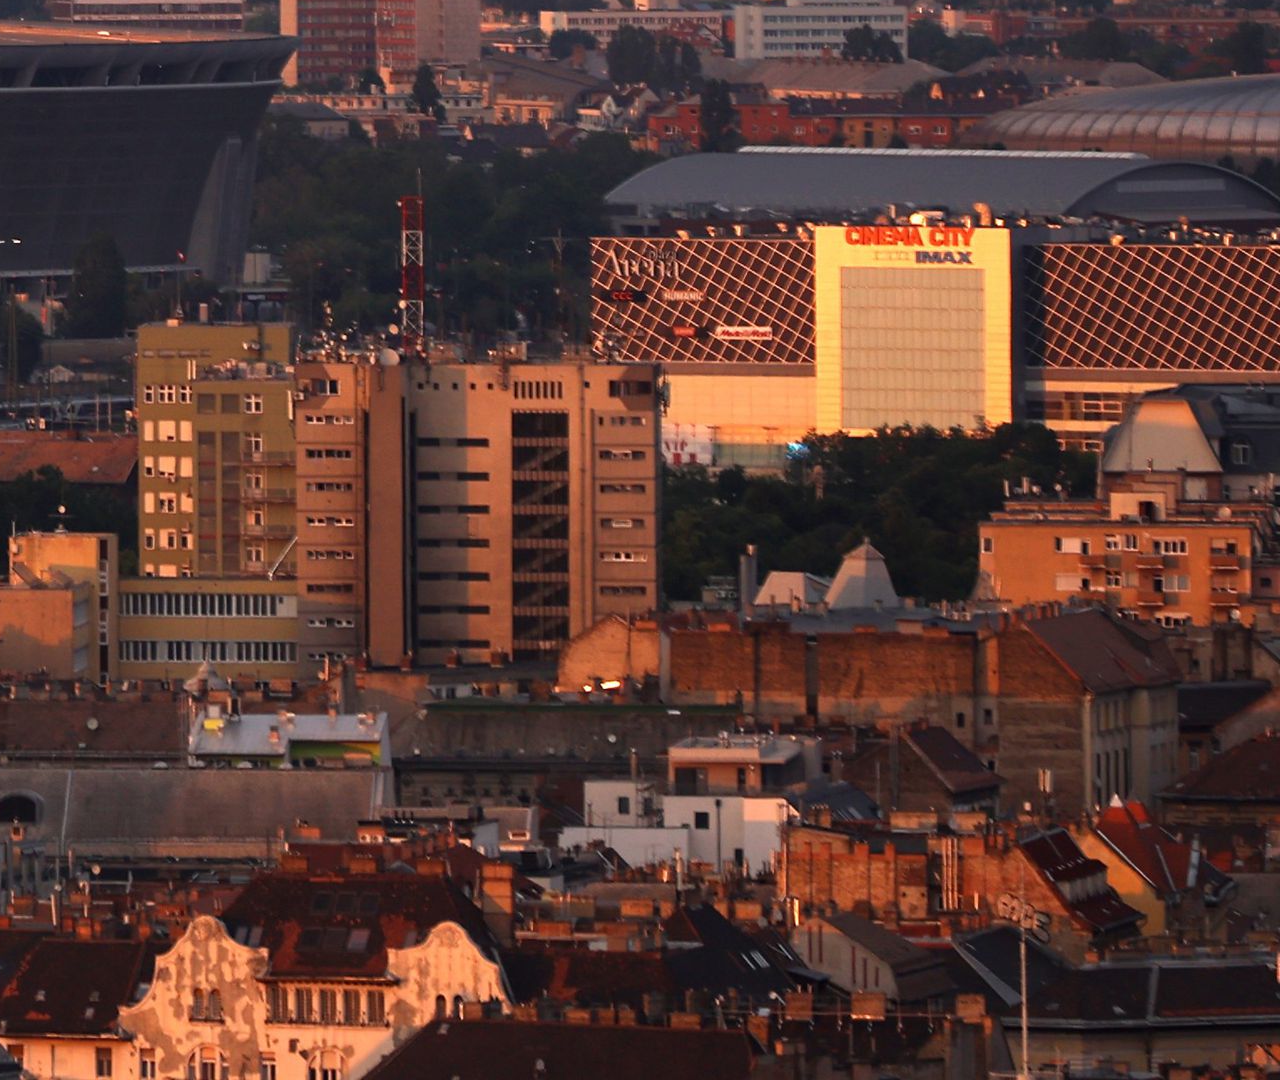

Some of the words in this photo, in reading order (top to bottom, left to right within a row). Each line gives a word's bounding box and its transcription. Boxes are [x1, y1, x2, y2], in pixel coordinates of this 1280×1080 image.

[845, 226, 924, 246] CINEMA
[929, 226, 975, 247] CITY
[607, 249, 684, 277] Arena
[915, 251, 973, 264] IMAX
